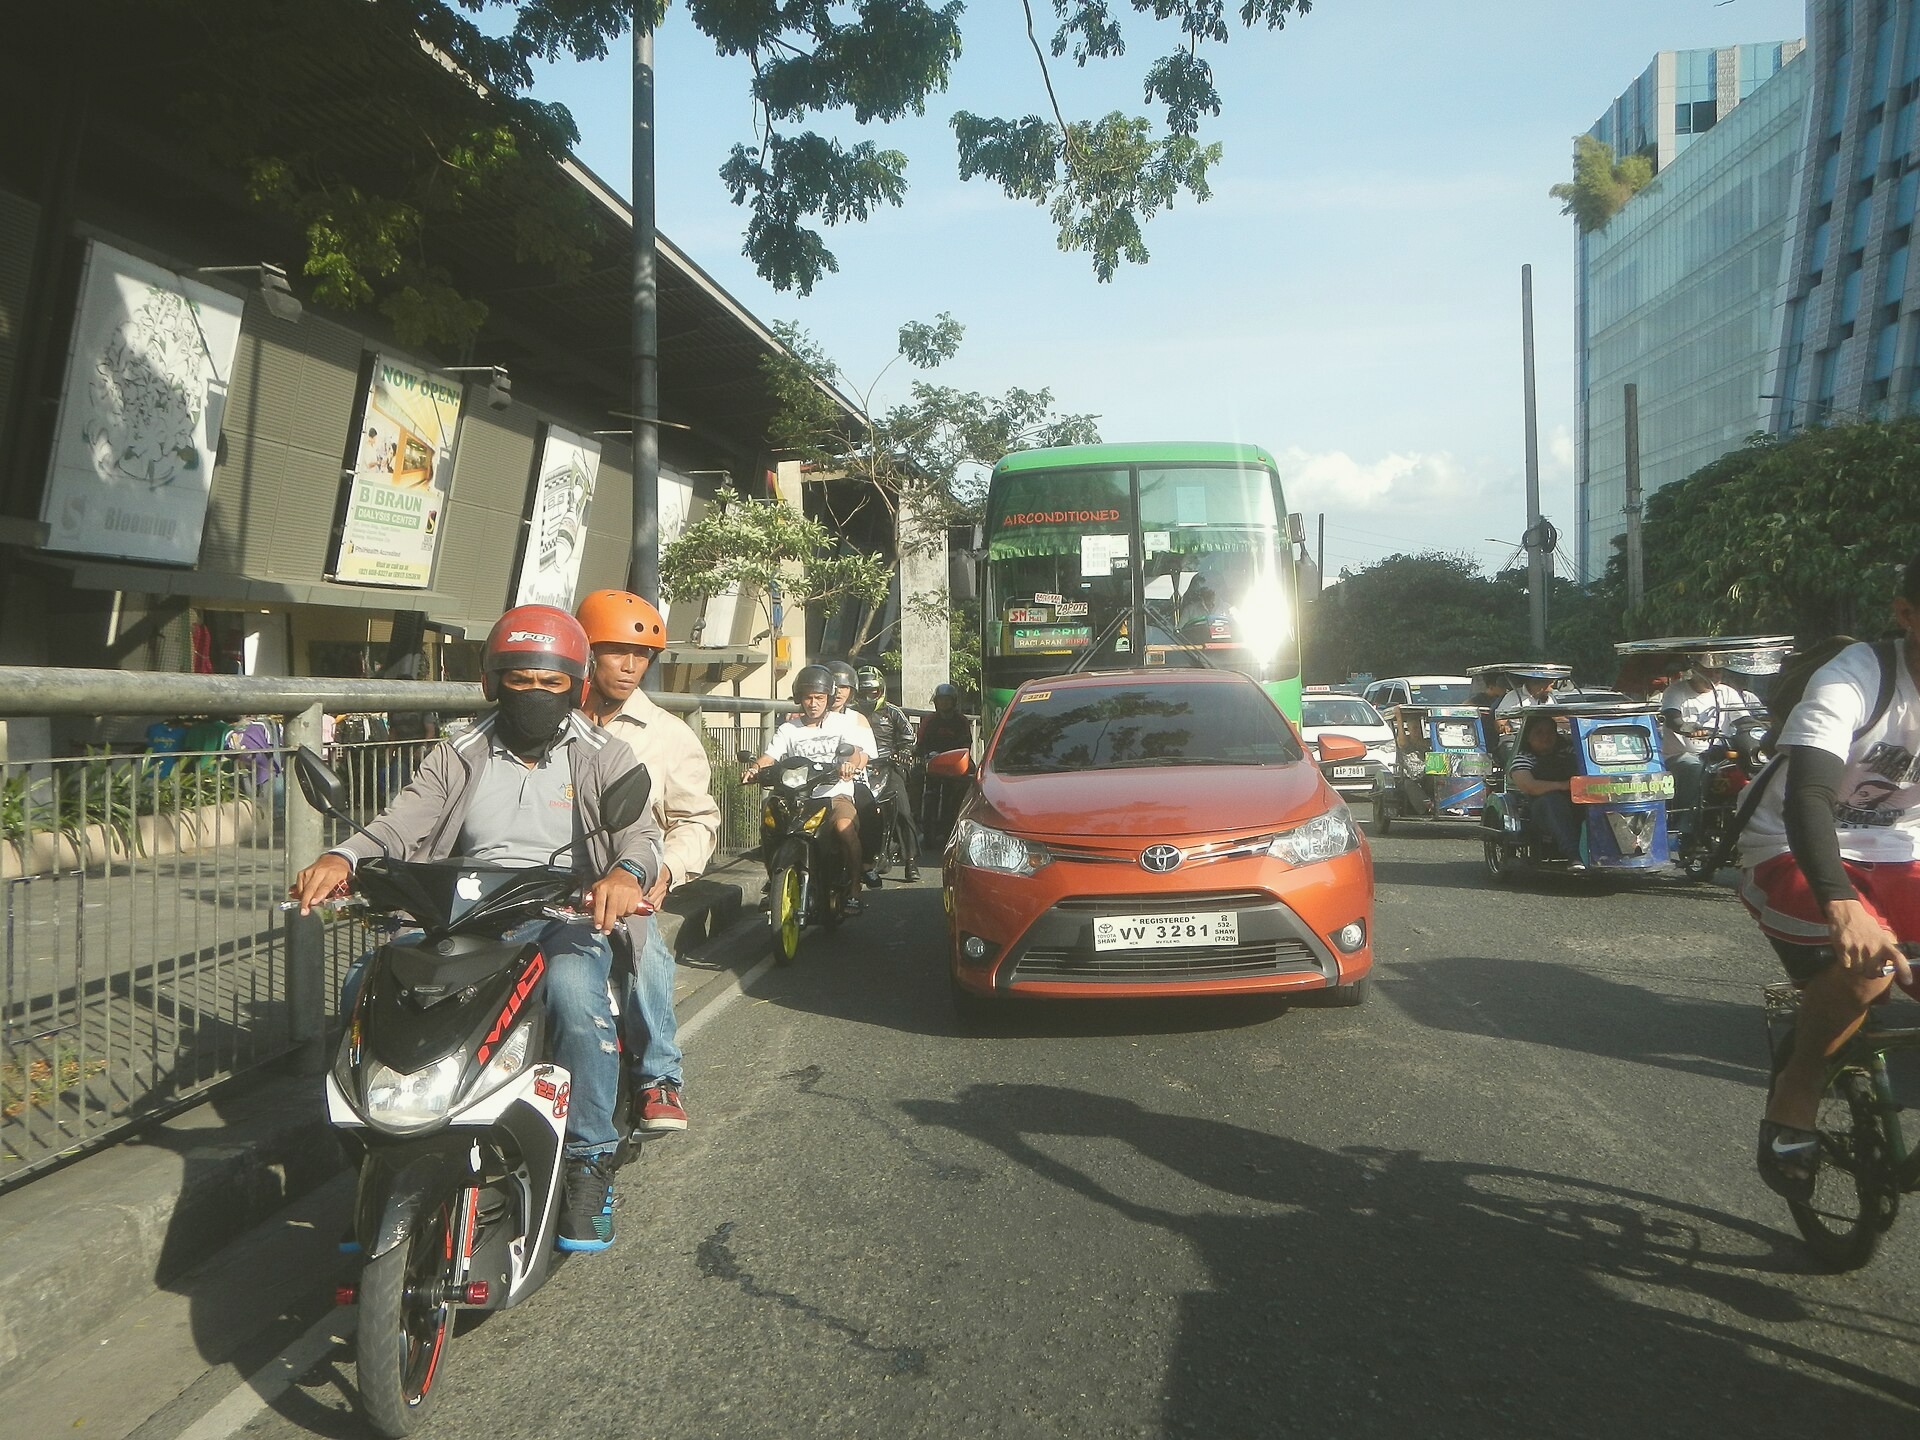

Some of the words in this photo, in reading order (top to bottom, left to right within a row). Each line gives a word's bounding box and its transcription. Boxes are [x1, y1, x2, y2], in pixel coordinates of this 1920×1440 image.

[382, 364, 417, 392] NOW
[420, 379, 460, 407] OPEN!
[359, 486, 370, 502] B
[374, 489, 422, 512] BRAUN
[104, 506, 177, 541] Blooming
[357, 507, 391, 521] DIALYSIS
[391, 513, 417, 526] CENTER
[1003, 509, 1120, 526] AIRCONDITIONED
[1010, 610, 1027, 622] SM
[1120, 926, 1146, 940] VV
[1156, 924, 1208, 939] 3281
[533, 1078, 557, 1102] 125
